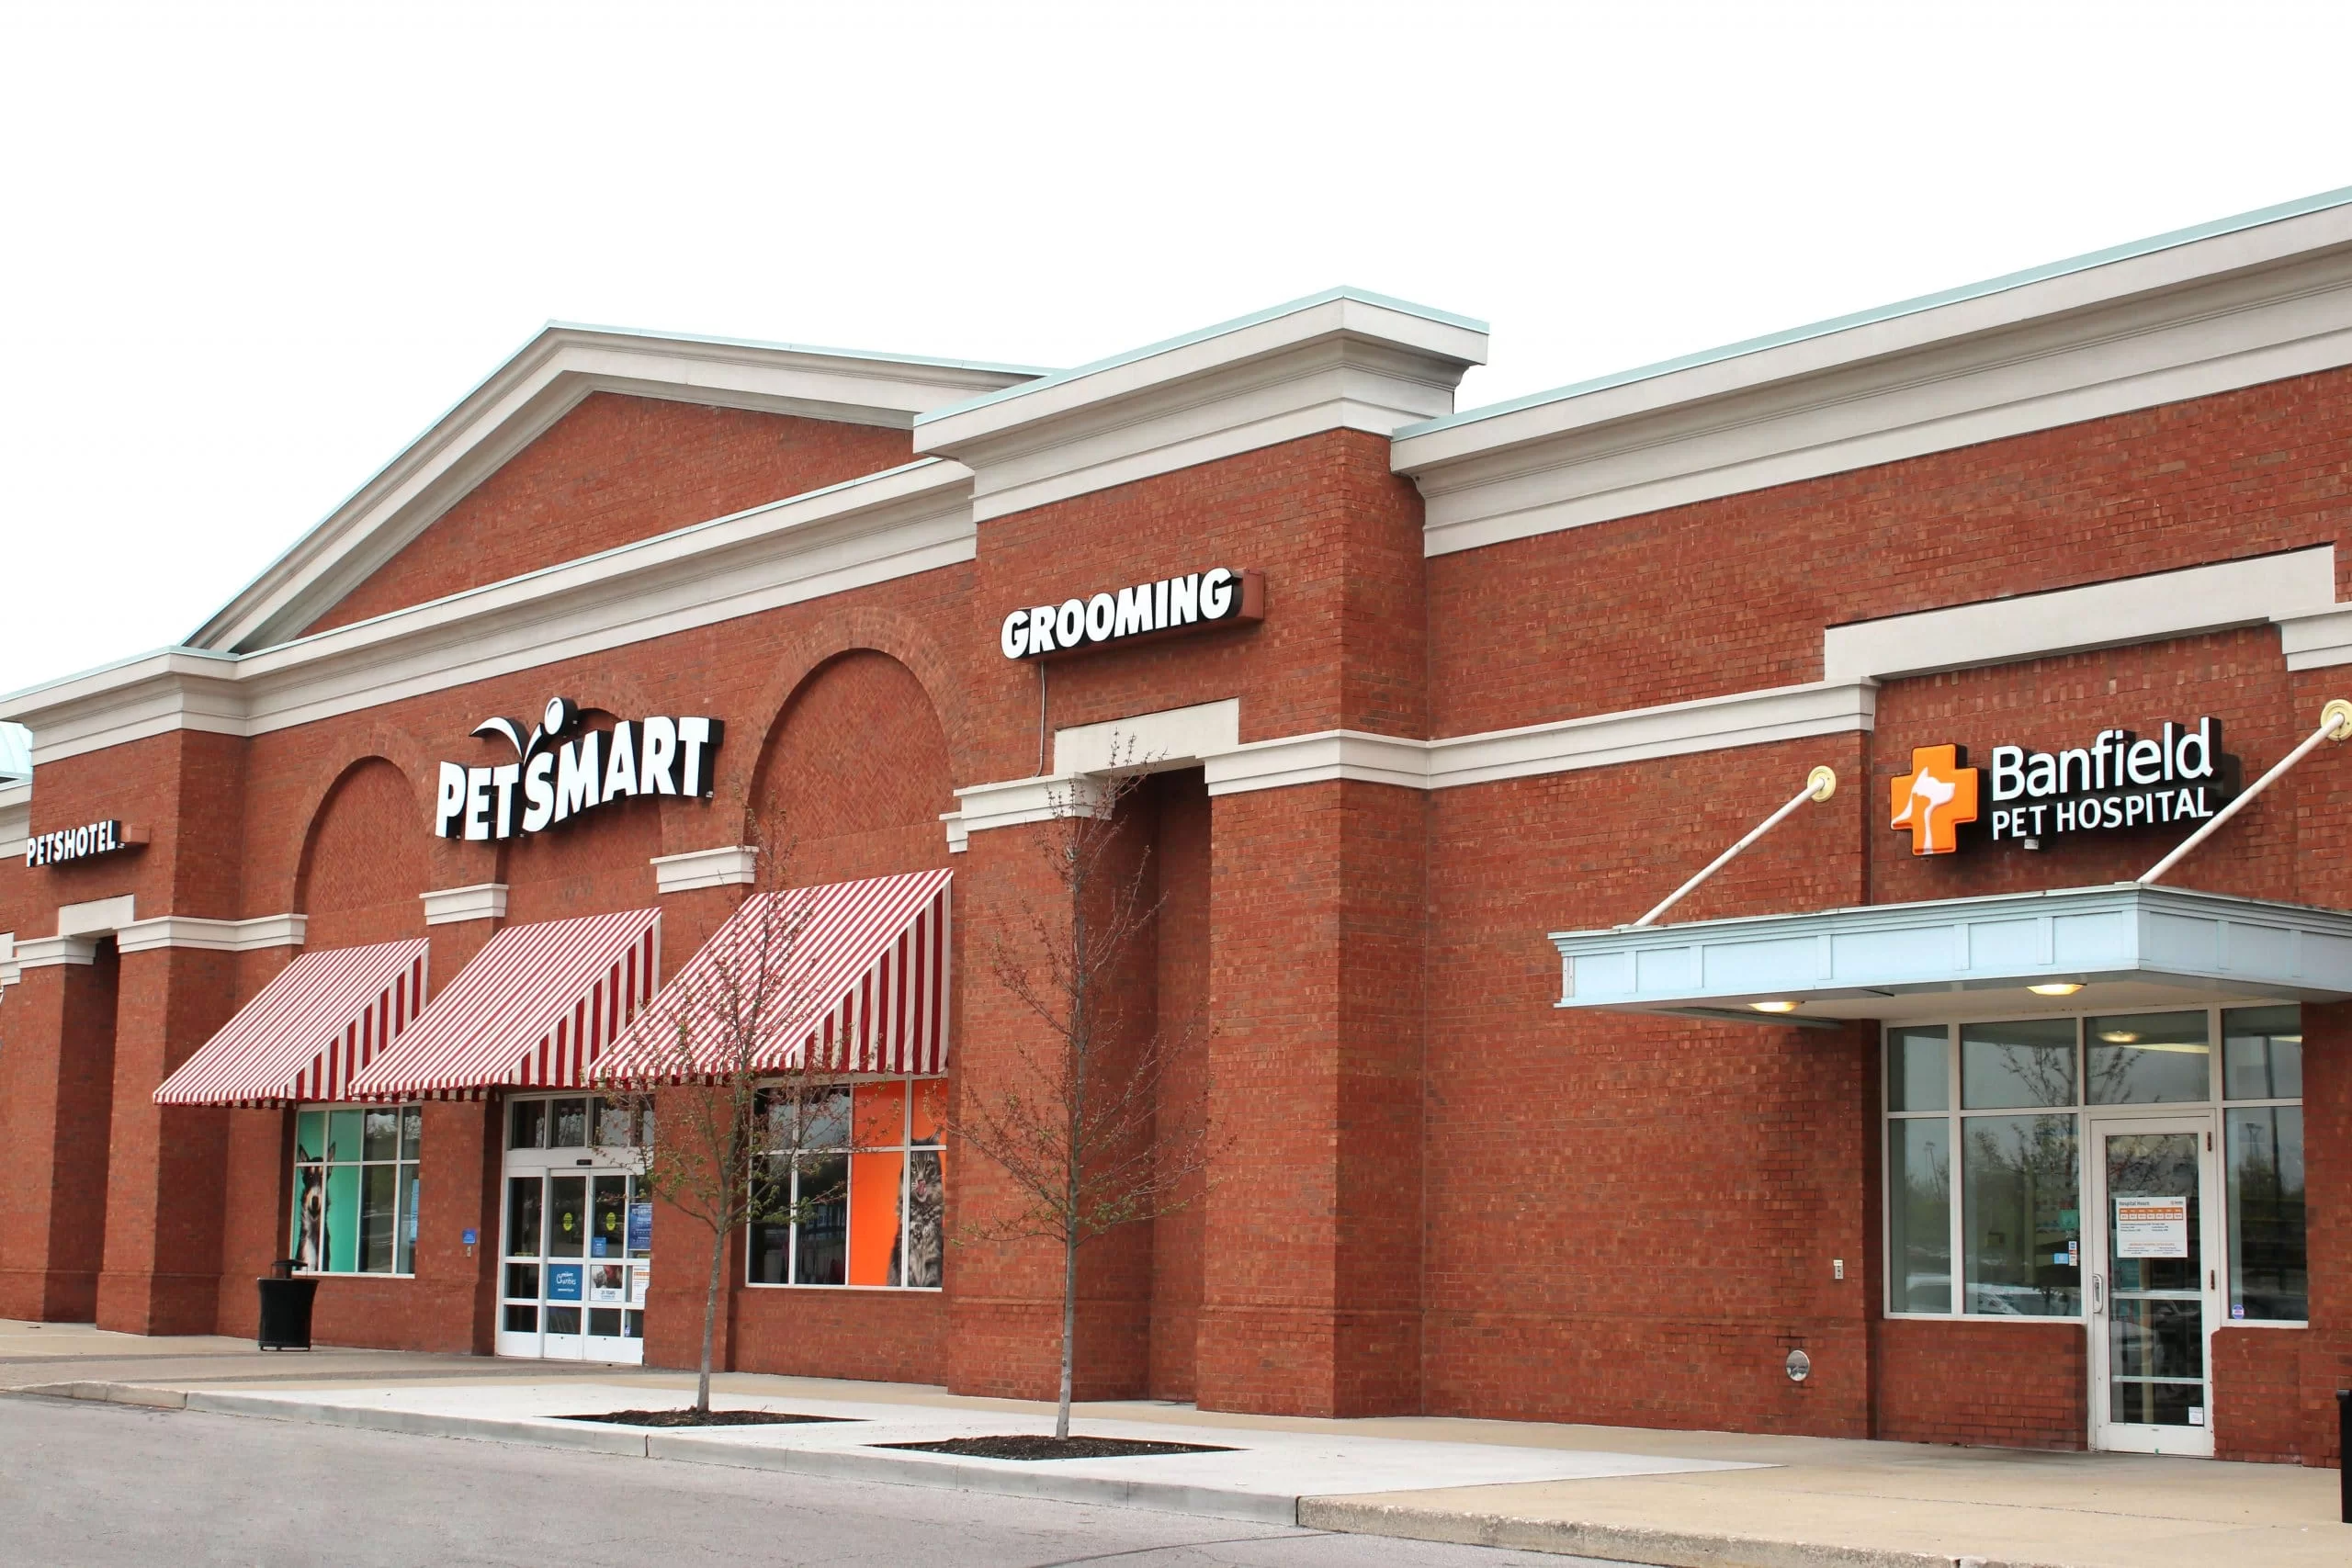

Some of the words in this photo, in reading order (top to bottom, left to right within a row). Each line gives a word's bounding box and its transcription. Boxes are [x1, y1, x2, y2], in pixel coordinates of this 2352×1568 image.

[1001, 567, 1233, 659] GROOMING
[435, 716, 710, 840] PETSMART
[1992, 716, 2213, 801] Banfield
[26, 819, 117, 867] PETSHOTEL
[1992, 805, 2048, 840] PET
[2057, 786, 2214, 832] HOSPITAL
